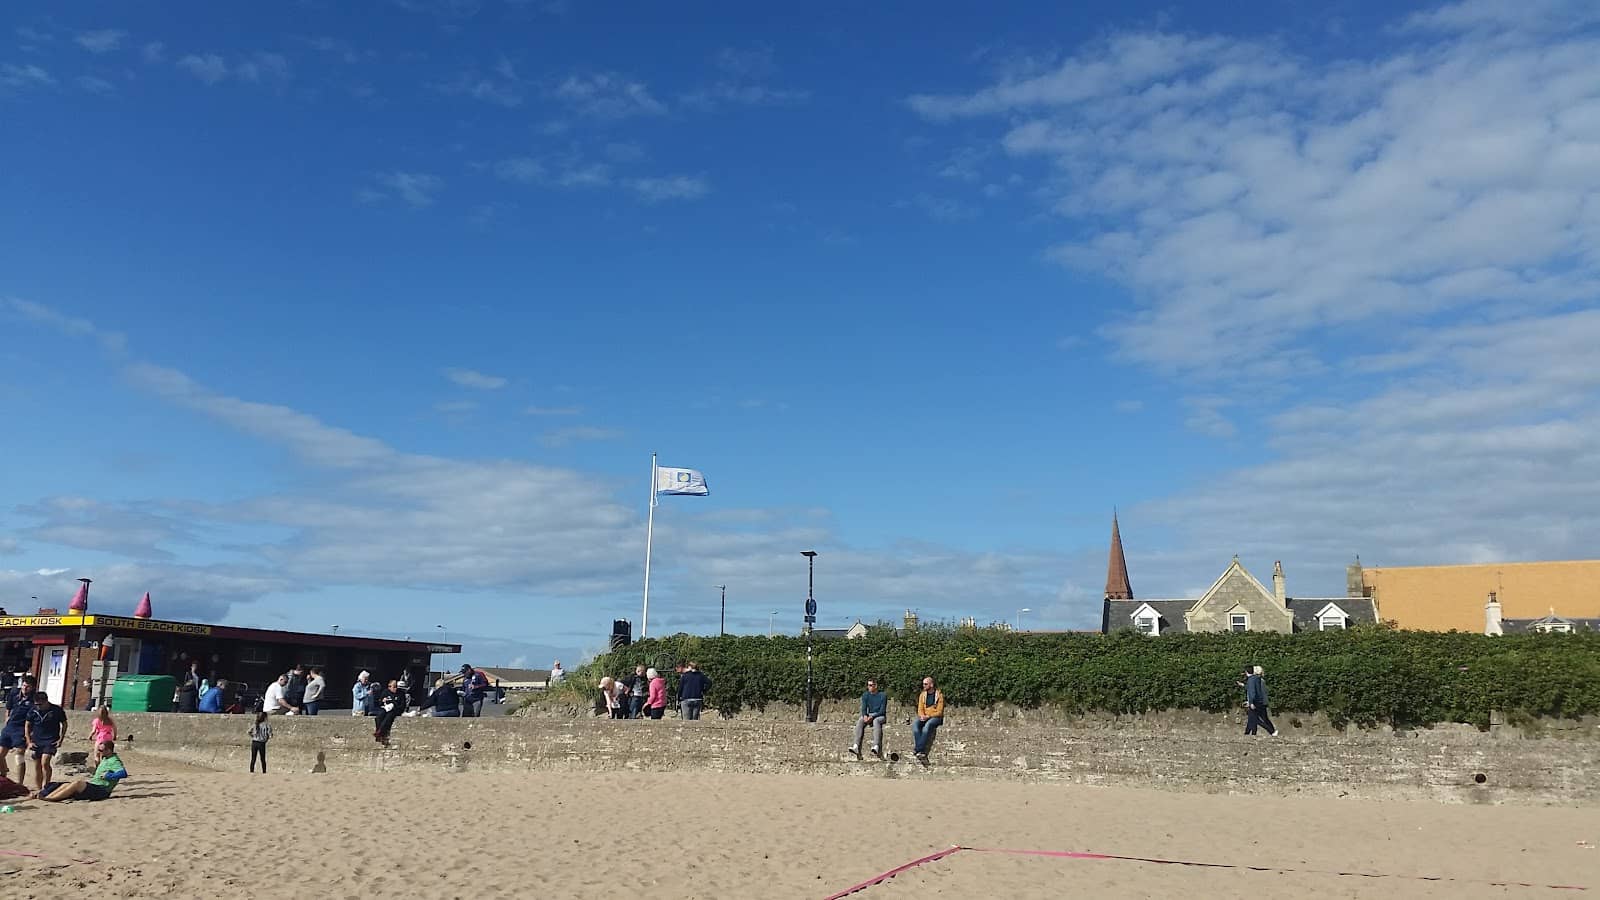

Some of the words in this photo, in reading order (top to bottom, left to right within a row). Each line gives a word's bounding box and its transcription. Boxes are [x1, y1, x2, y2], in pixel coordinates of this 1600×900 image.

[31, 617, 62, 625] KIOSK
[98, 617, 134, 628] SOUTH
[138, 621, 173, 631] BEACH
[176, 625, 207, 634] KIOSK
